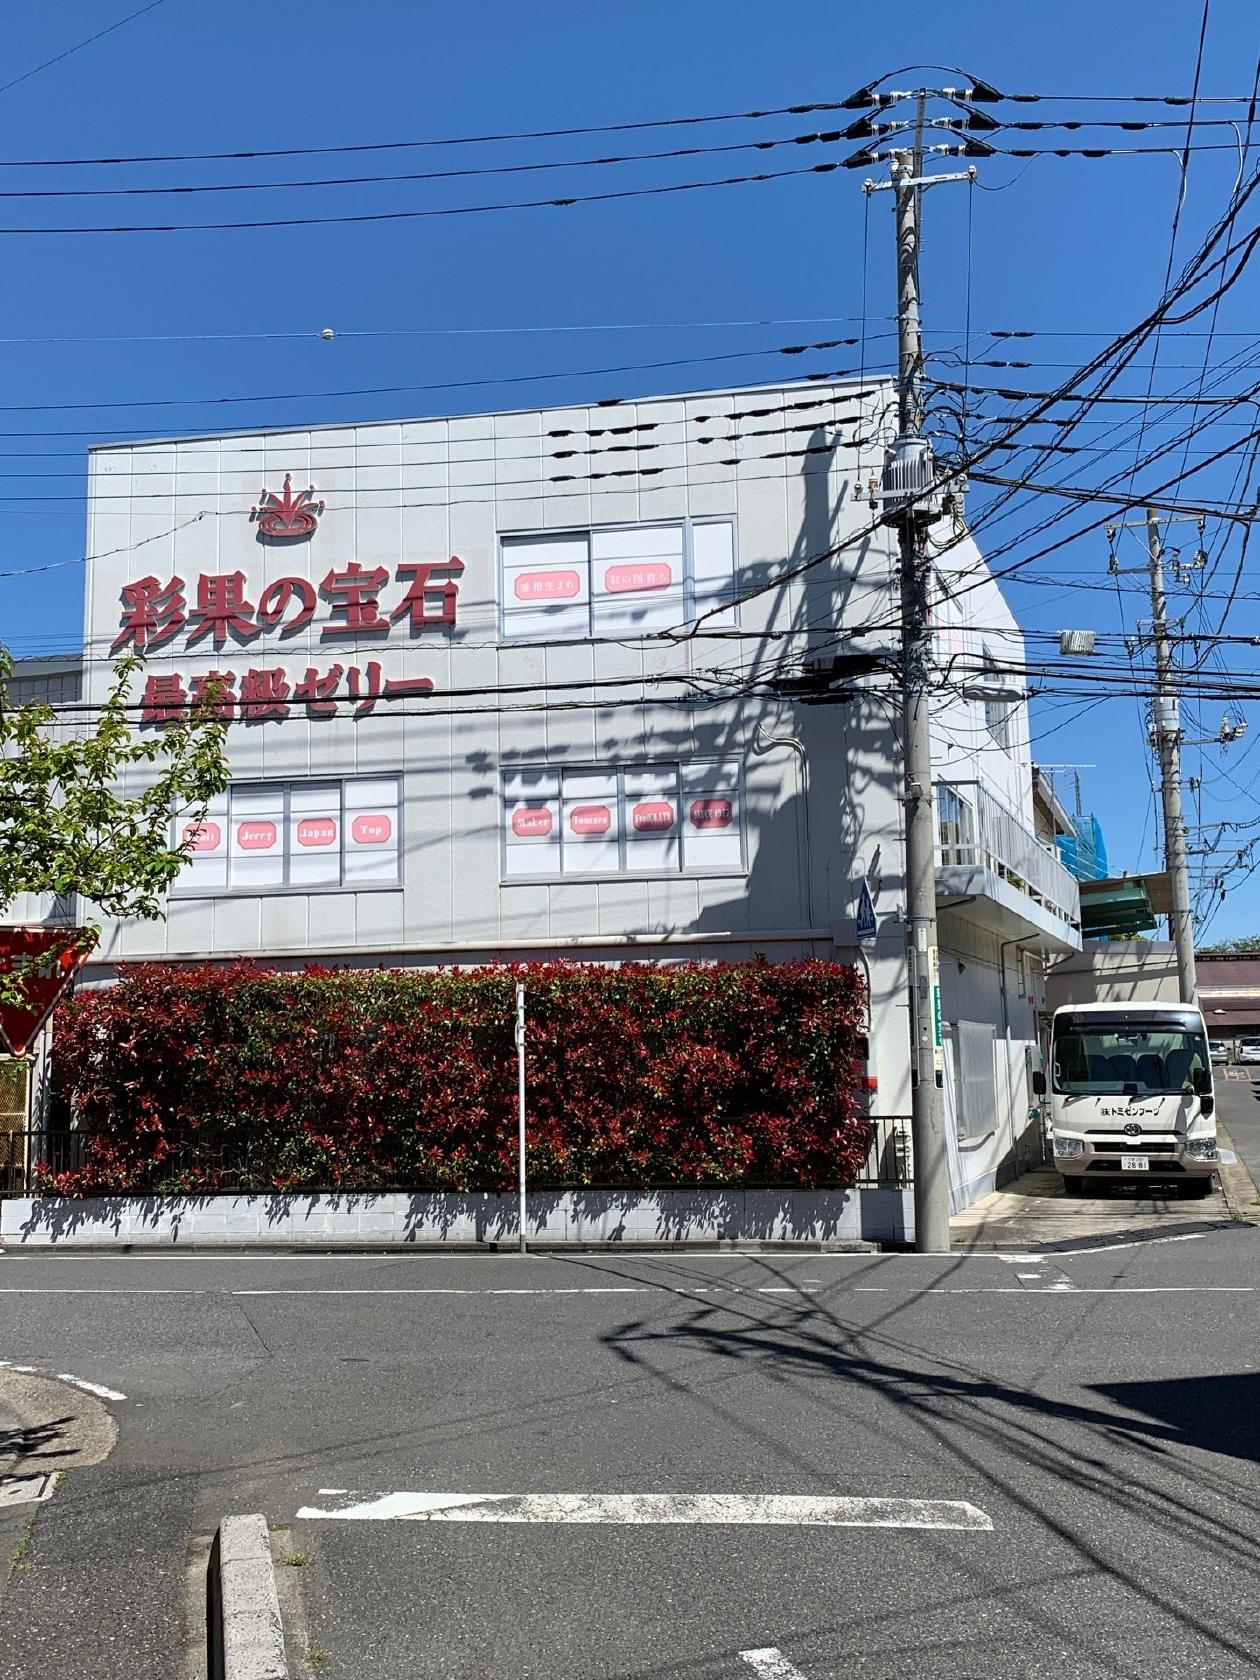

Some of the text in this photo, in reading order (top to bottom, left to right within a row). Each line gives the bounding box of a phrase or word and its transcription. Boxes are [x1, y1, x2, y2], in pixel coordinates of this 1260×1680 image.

[110, 555, 466, 650] 彩果の宝石
[141, 661, 435, 722] 最高級ゼリー
[515, 817, 551, 828] Maker
[241, 830, 273, 842] Jerry
[300, 828, 334, 840] Japan
[360, 825, 383, 837] Top
